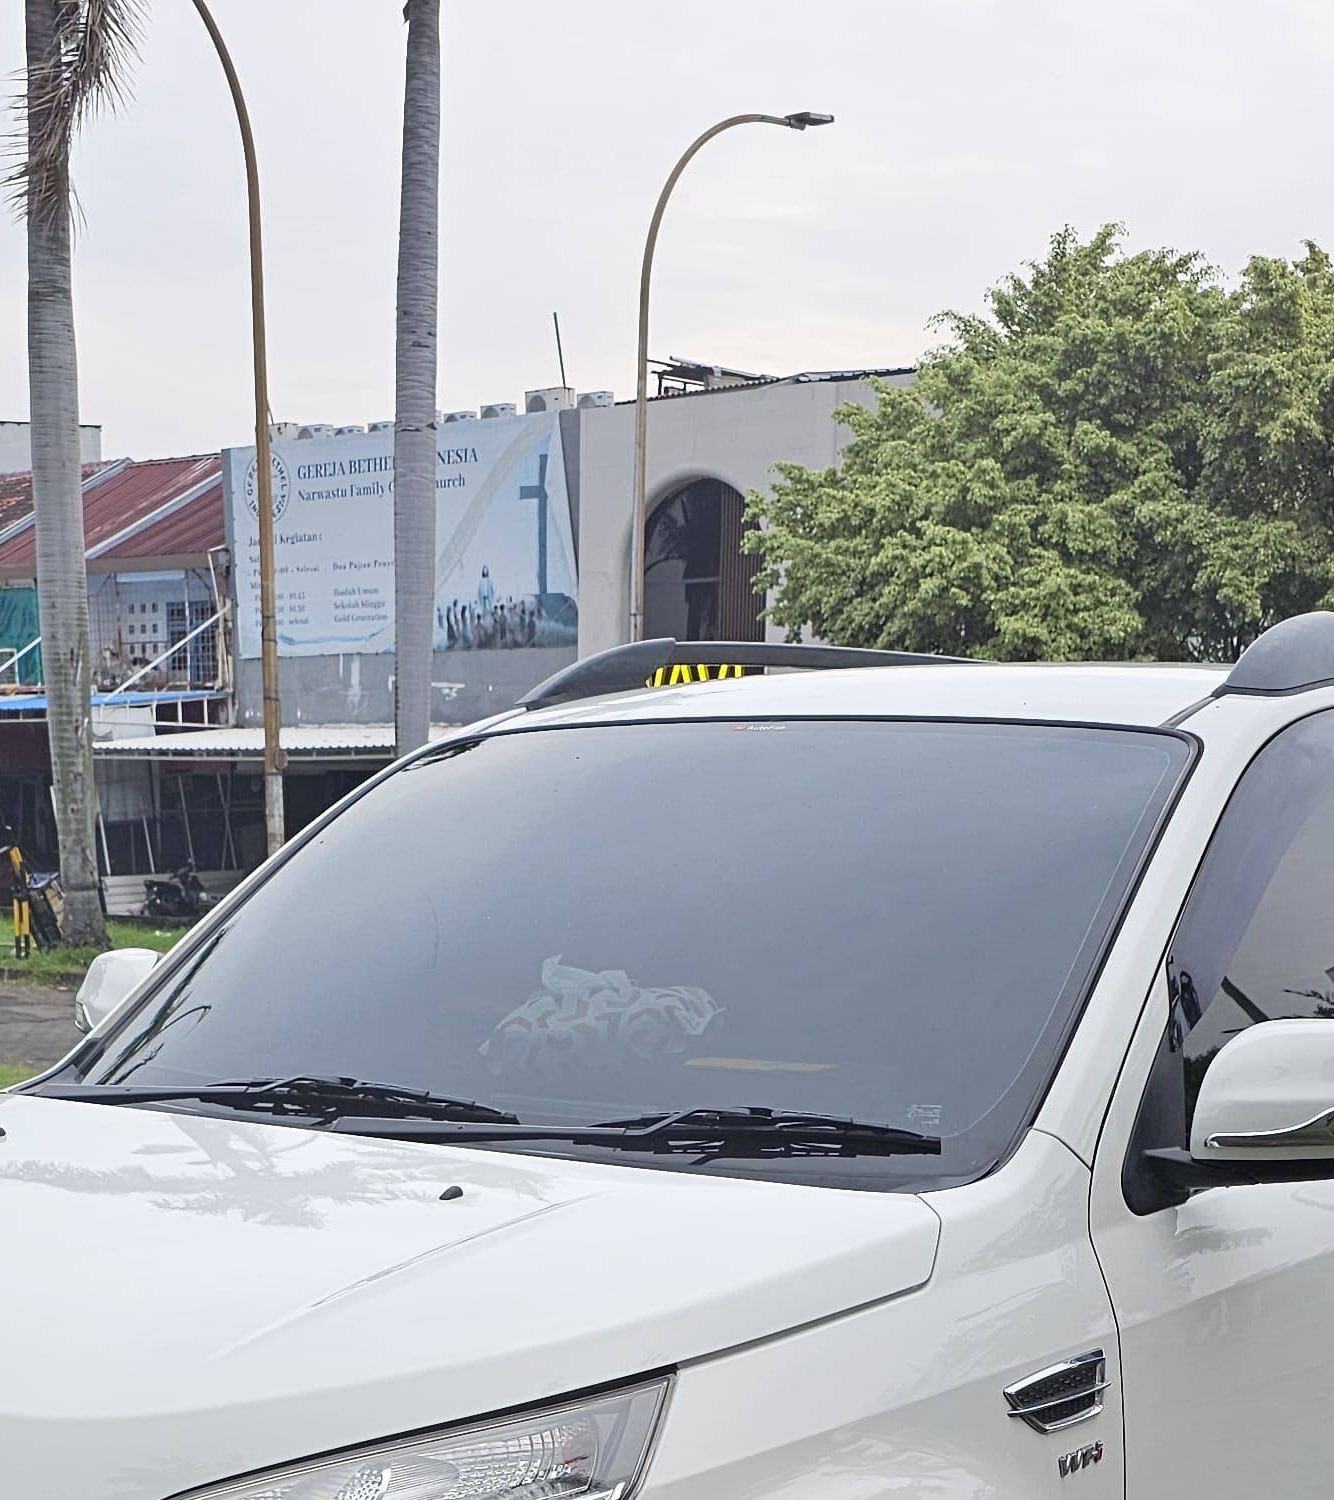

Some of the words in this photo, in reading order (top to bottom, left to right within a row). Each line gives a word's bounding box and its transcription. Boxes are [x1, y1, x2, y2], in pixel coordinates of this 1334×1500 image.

[297, 461, 346, 481] GEREJA
[437, 447, 478, 464] NESIA
[298, 486, 348, 502] Narwastu
[350, 481, 385, 498] Family
